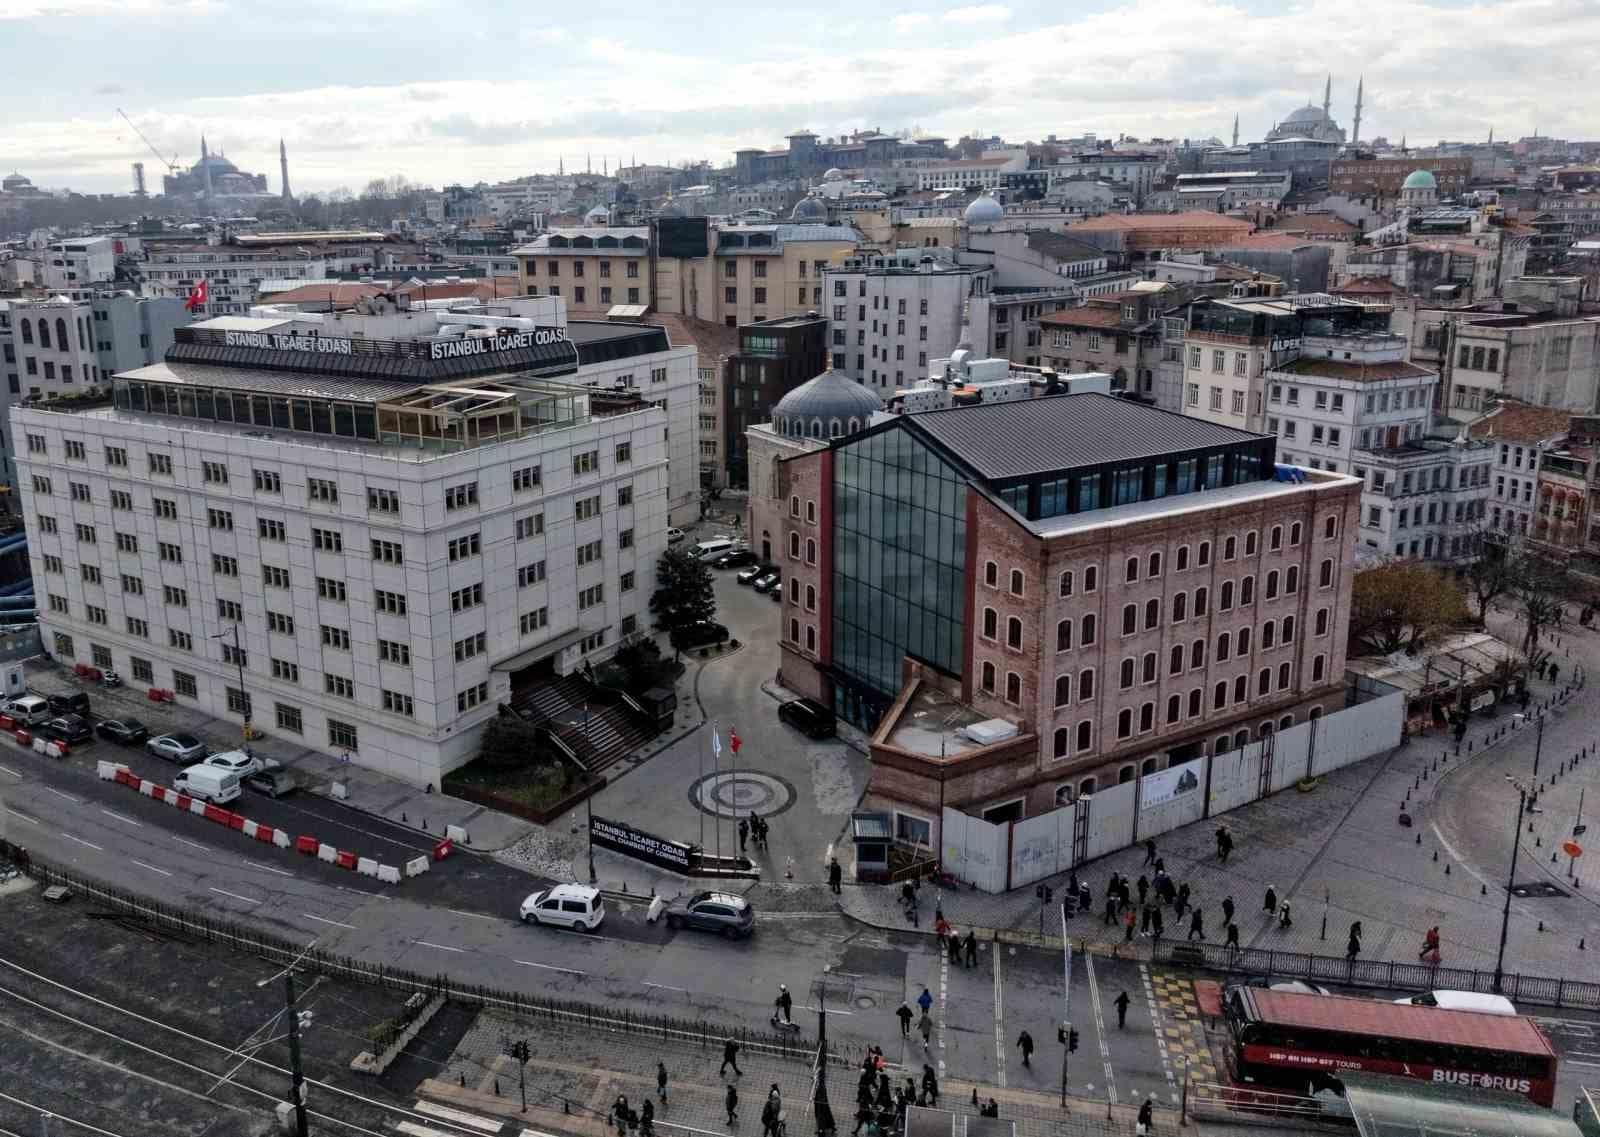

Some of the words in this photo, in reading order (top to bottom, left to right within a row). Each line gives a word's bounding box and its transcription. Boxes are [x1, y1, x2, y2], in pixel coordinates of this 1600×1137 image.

[318, 338, 352, 355] ODASI
[432, 340, 487, 359] İSTANBUL
[488, 333, 534, 352] TİCARET
[535, 328, 566, 345] ODASI
